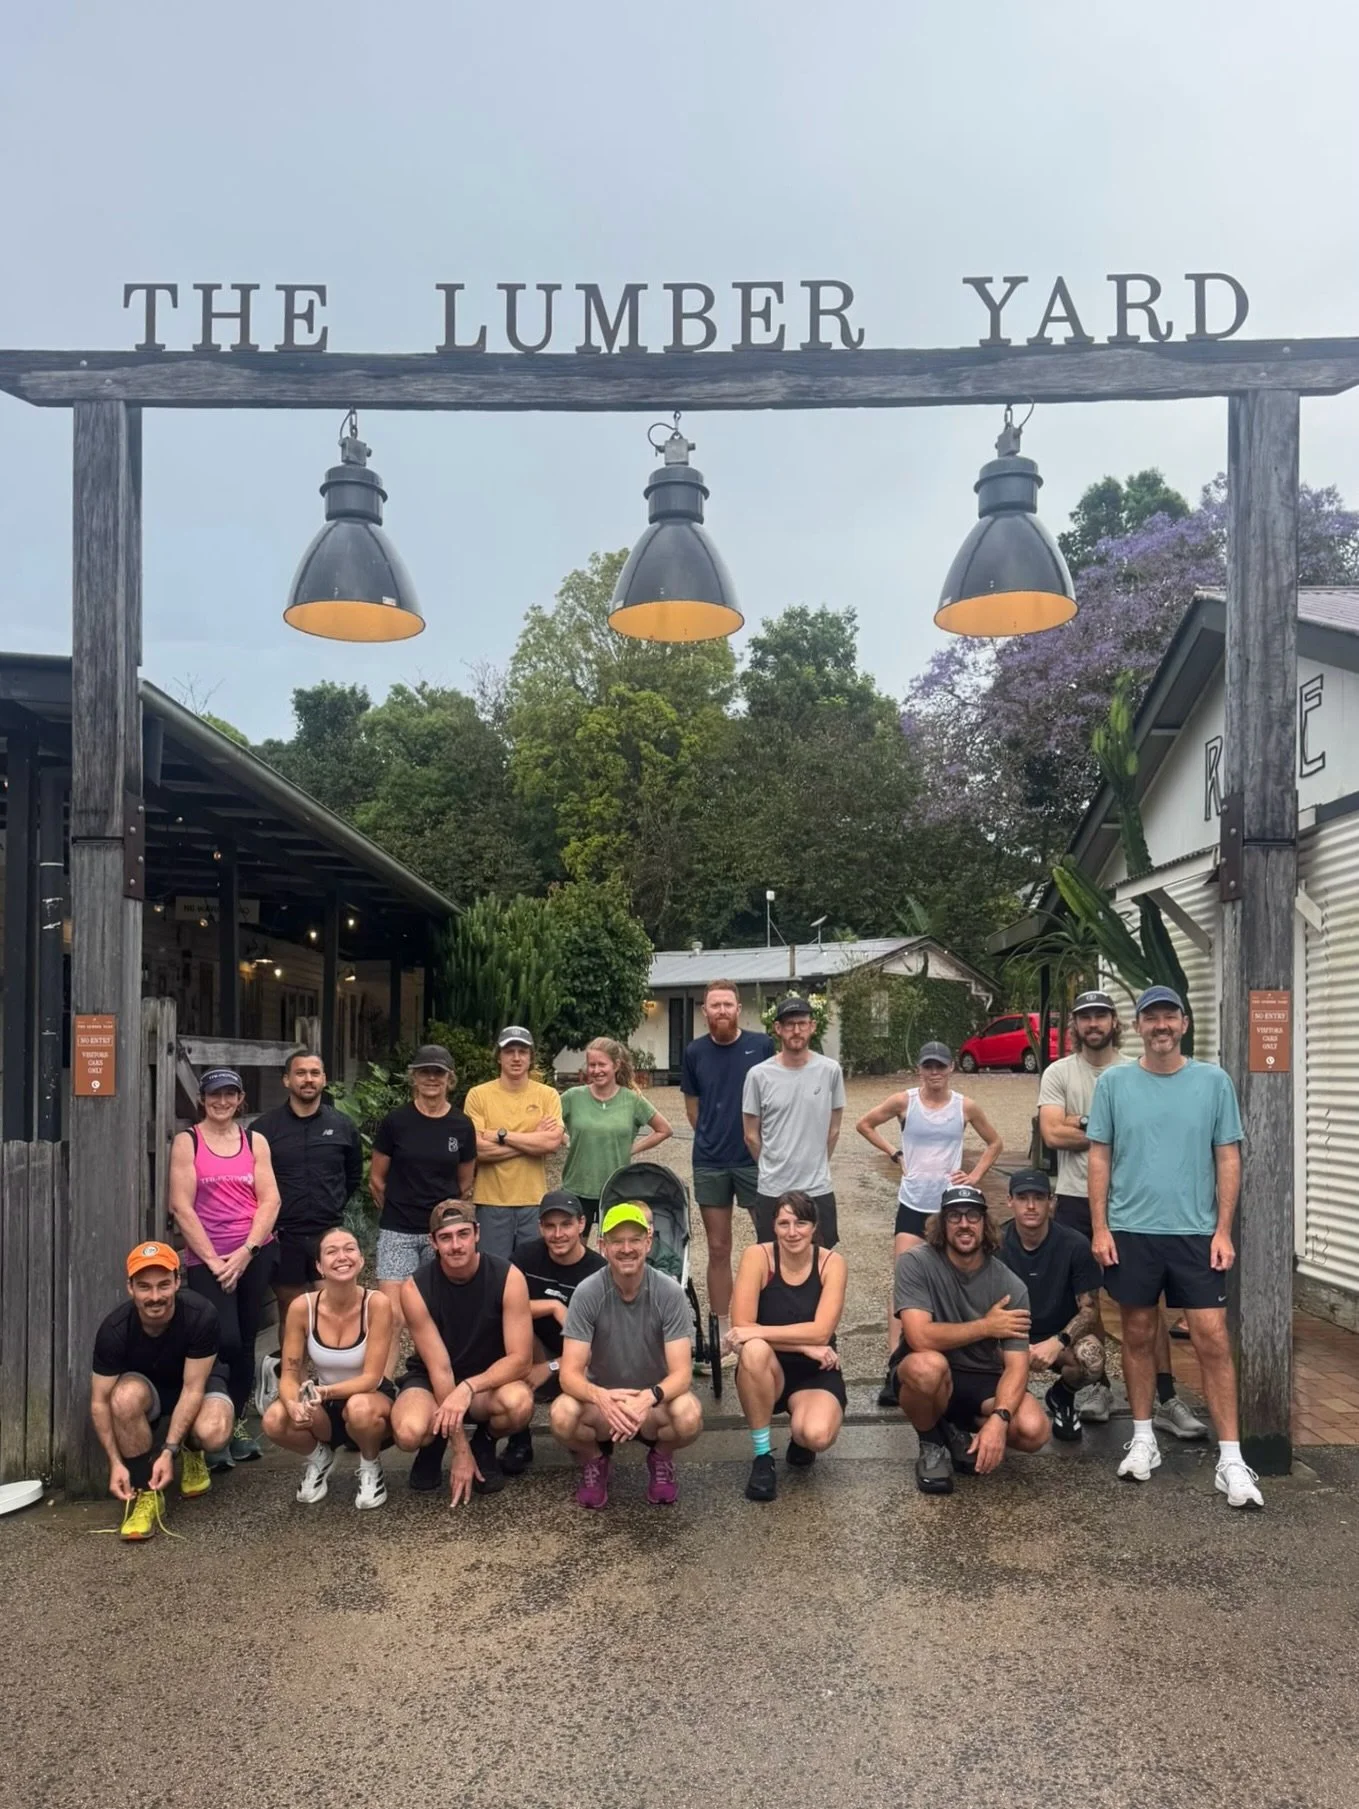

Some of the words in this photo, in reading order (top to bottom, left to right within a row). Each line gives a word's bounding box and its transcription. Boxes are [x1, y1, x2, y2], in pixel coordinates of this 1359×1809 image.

[123, 283, 328, 352] THE
[435, 280, 865, 354] LUMBER
[962, 272, 1249, 347] YARD
